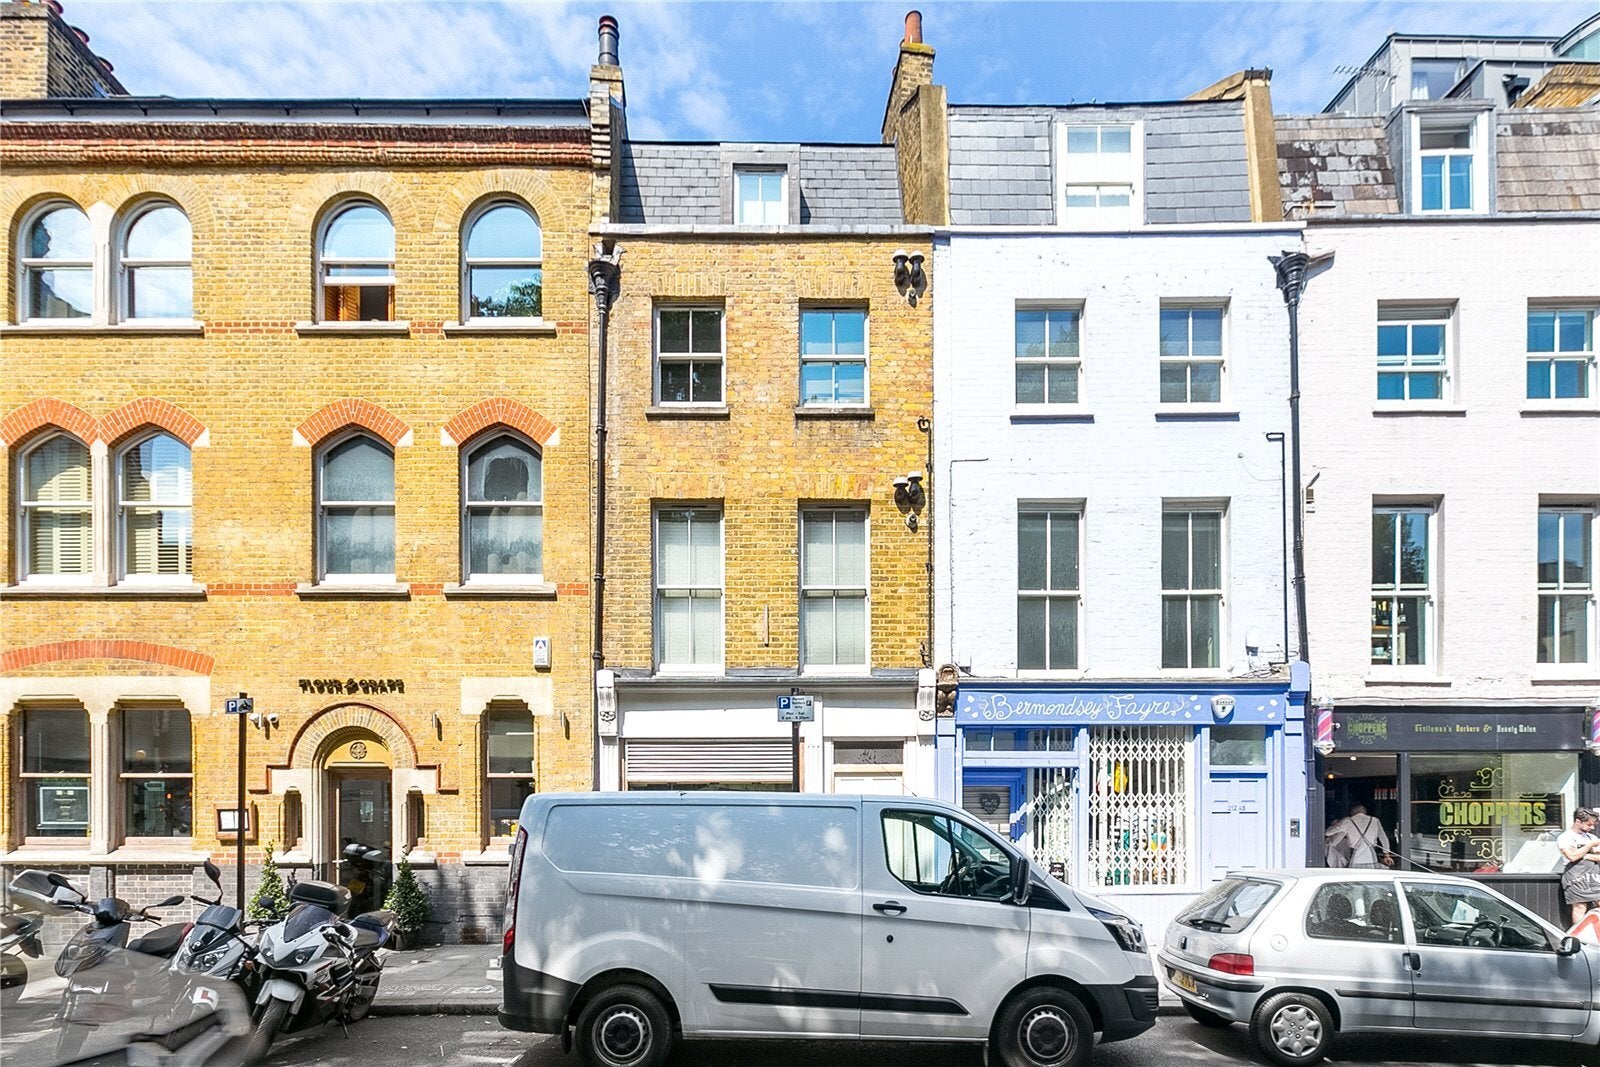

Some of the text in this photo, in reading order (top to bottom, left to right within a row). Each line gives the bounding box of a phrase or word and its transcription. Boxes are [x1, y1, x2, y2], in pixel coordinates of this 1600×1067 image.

[228, 701, 235, 711] P
[780, 698, 788, 708] P
[985, 694, 1170, 720] Bermondsey Fayre
[1347, 723, 1387, 733] CHOPPERS
[1483, 724, 1492, 732] &
[1519, 724, 1536, 732] Salon
[1440, 802, 1546, 825] CHOPPERS
